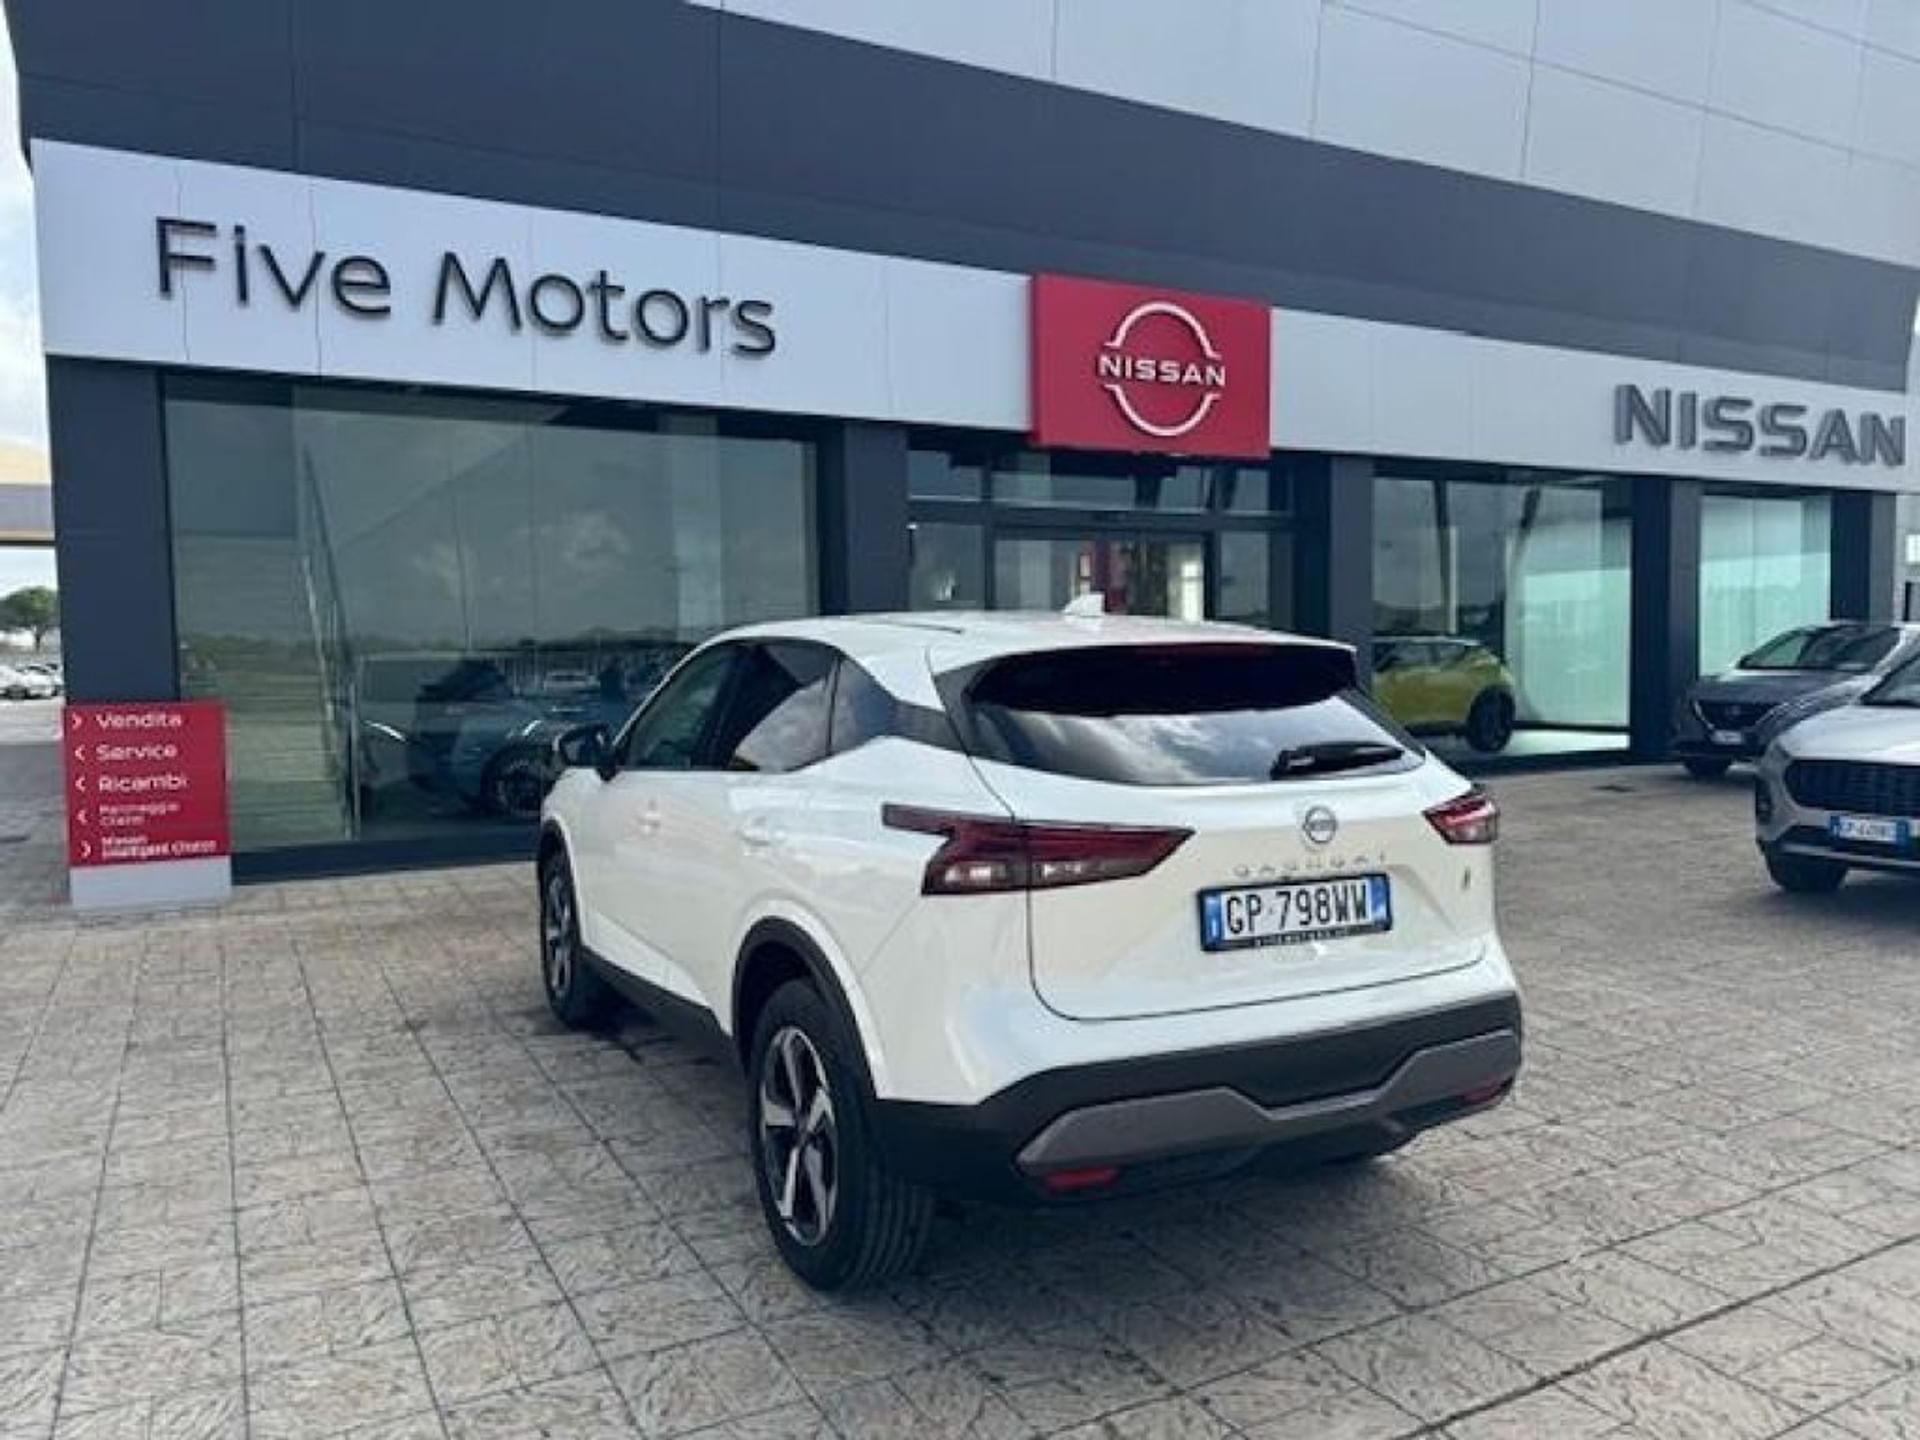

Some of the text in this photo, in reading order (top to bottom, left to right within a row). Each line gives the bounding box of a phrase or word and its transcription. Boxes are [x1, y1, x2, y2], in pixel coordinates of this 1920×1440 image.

[156, 215, 777, 357] Five Motors
[1099, 355, 1226, 387] NISSAN
[1614, 384, 1907, 467] NISSAN
[95, 713, 182, 729] Vendita
[96, 744, 178, 761] Service
[99, 772, 189, 792] Ricambi
[1226, 893, 1262, 935] GP
[1275, 884, 1368, 930] 798WW
